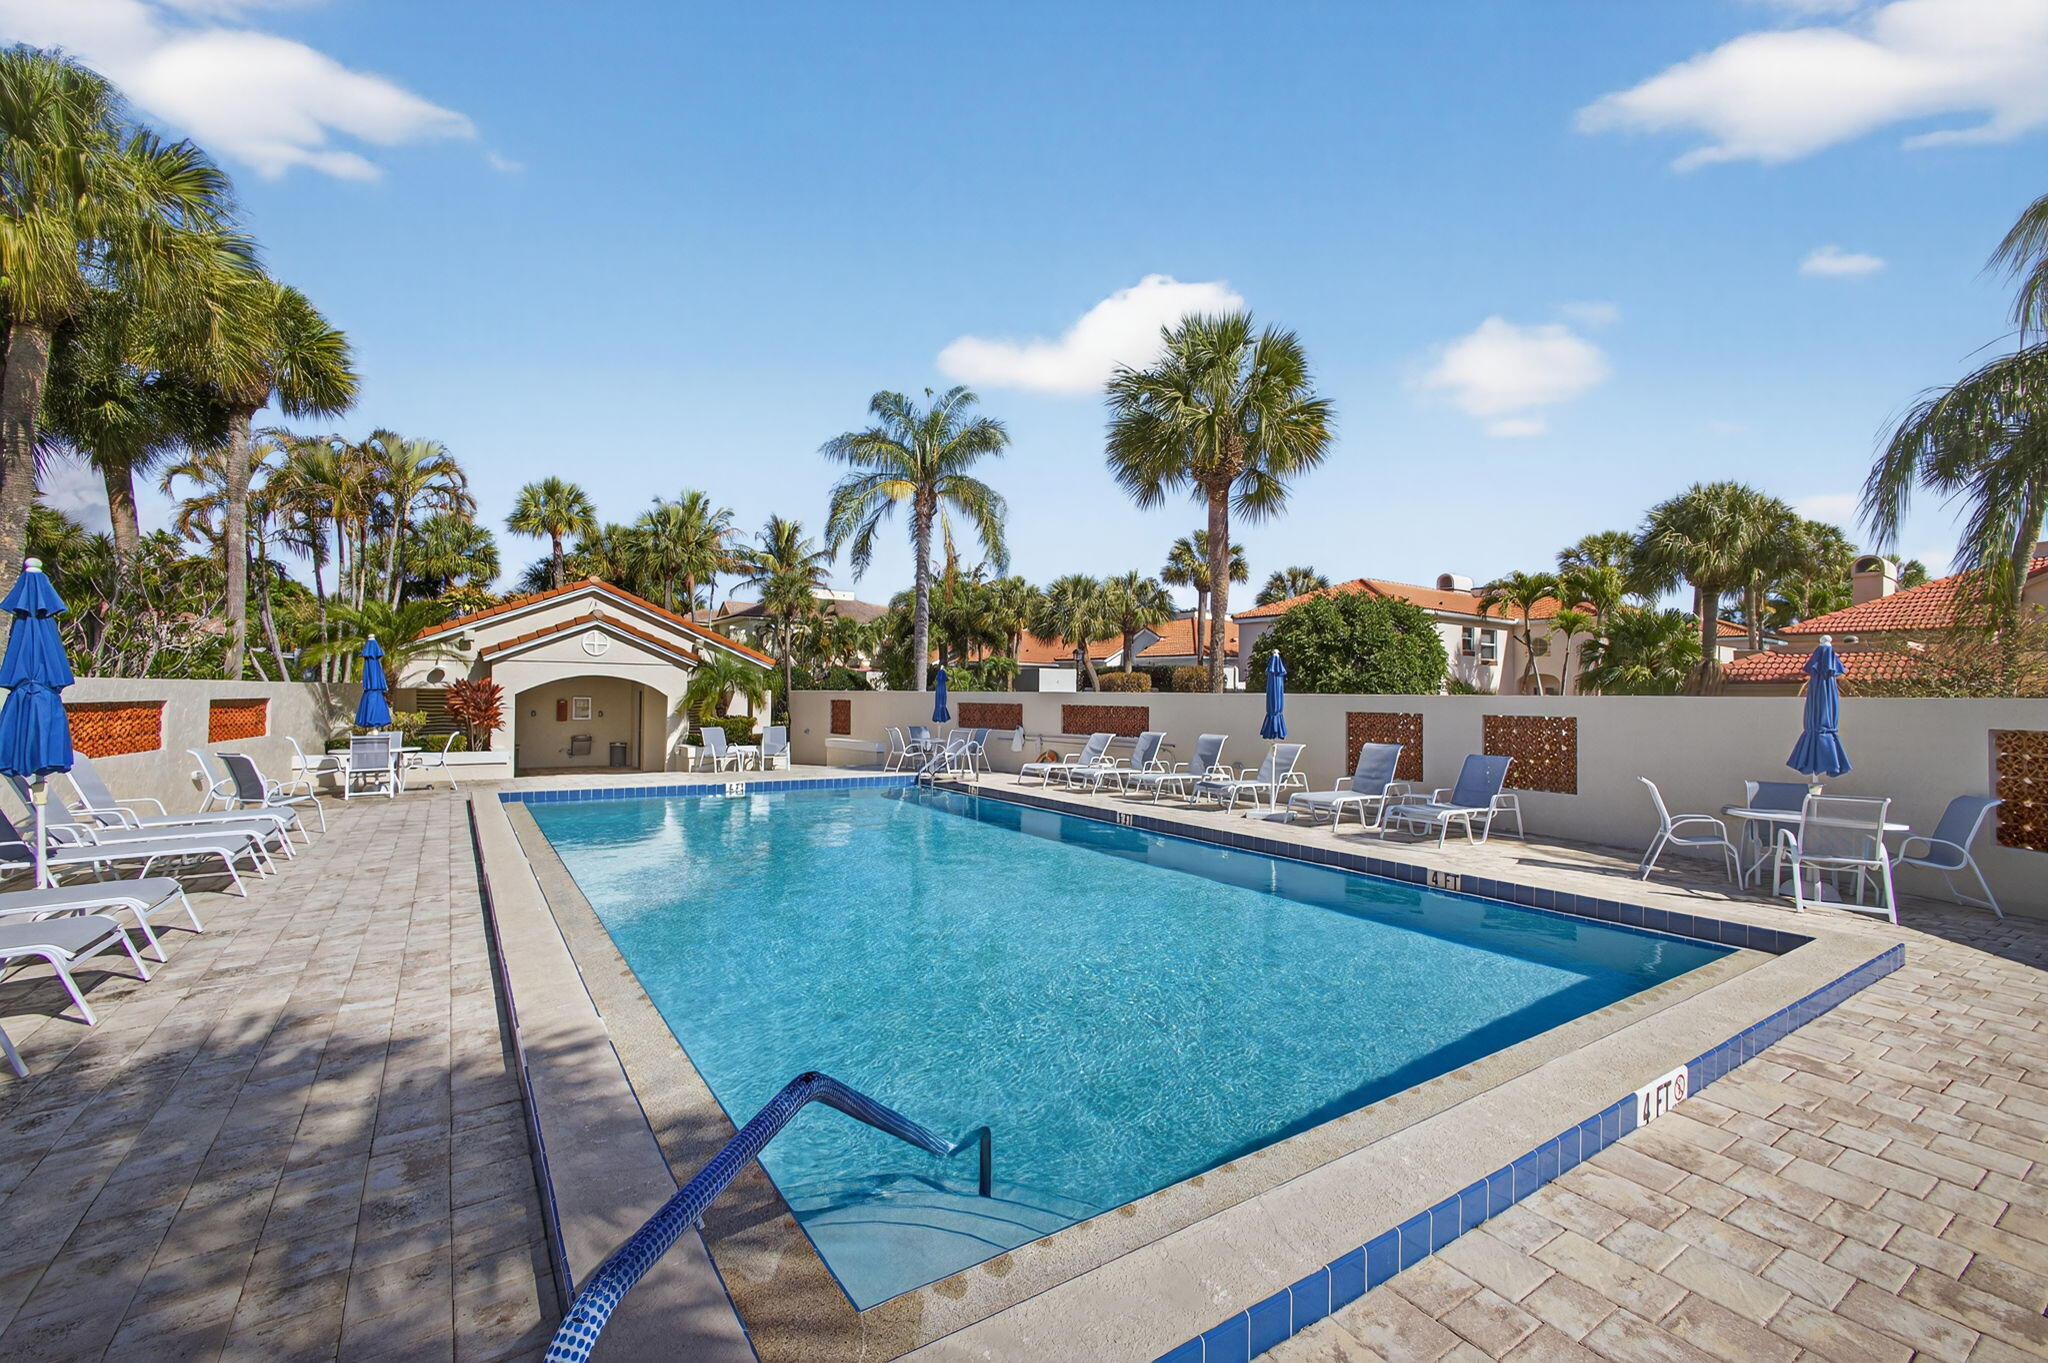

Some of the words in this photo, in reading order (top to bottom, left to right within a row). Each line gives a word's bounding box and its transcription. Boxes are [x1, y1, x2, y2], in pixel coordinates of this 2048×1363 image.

[1431, 871, 1438, 885] 4
[1444, 872, 1459, 891] FT
[1643, 1092, 1650, 1125] 4
[1656, 1080, 1671, 1118] FT
